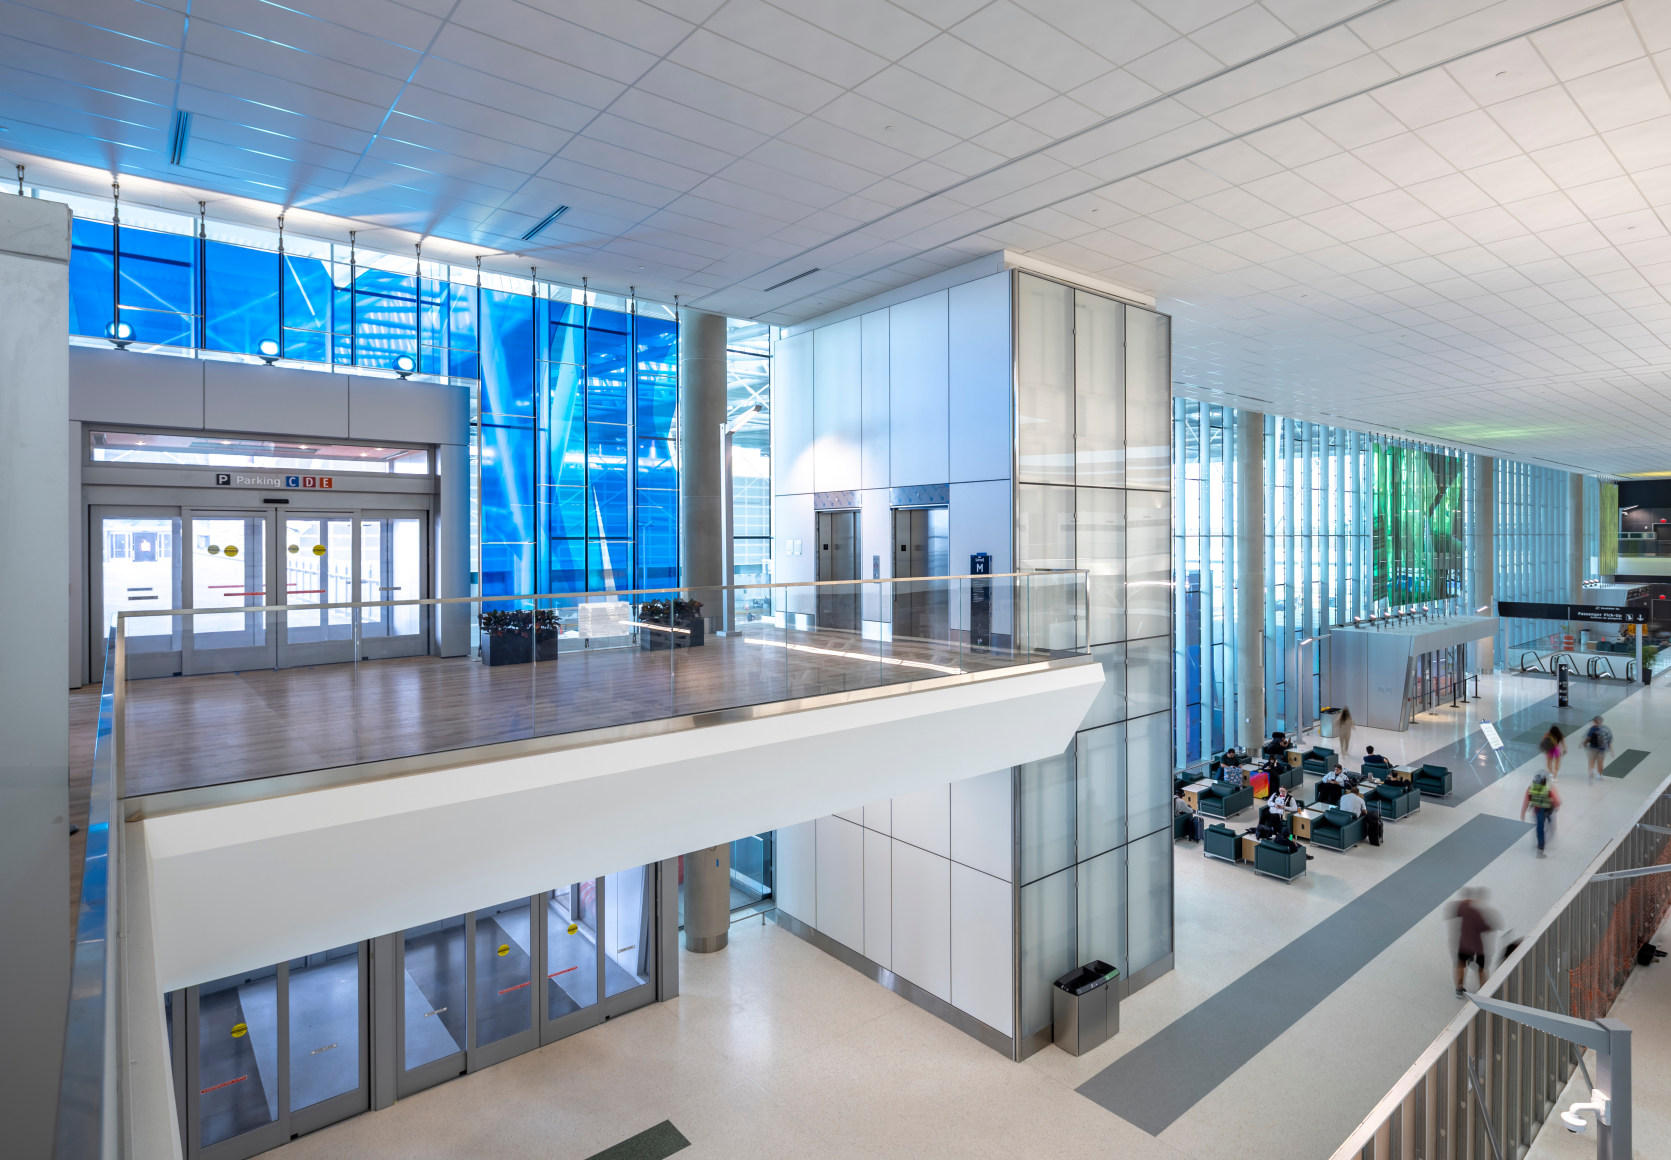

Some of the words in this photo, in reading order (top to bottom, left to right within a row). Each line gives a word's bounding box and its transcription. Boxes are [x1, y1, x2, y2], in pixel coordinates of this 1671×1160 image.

[236, 475, 281, 487] Parking
[288, 476, 297, 487] C
[305, 477, 313, 487] D
[976, 563, 984, 573] M
